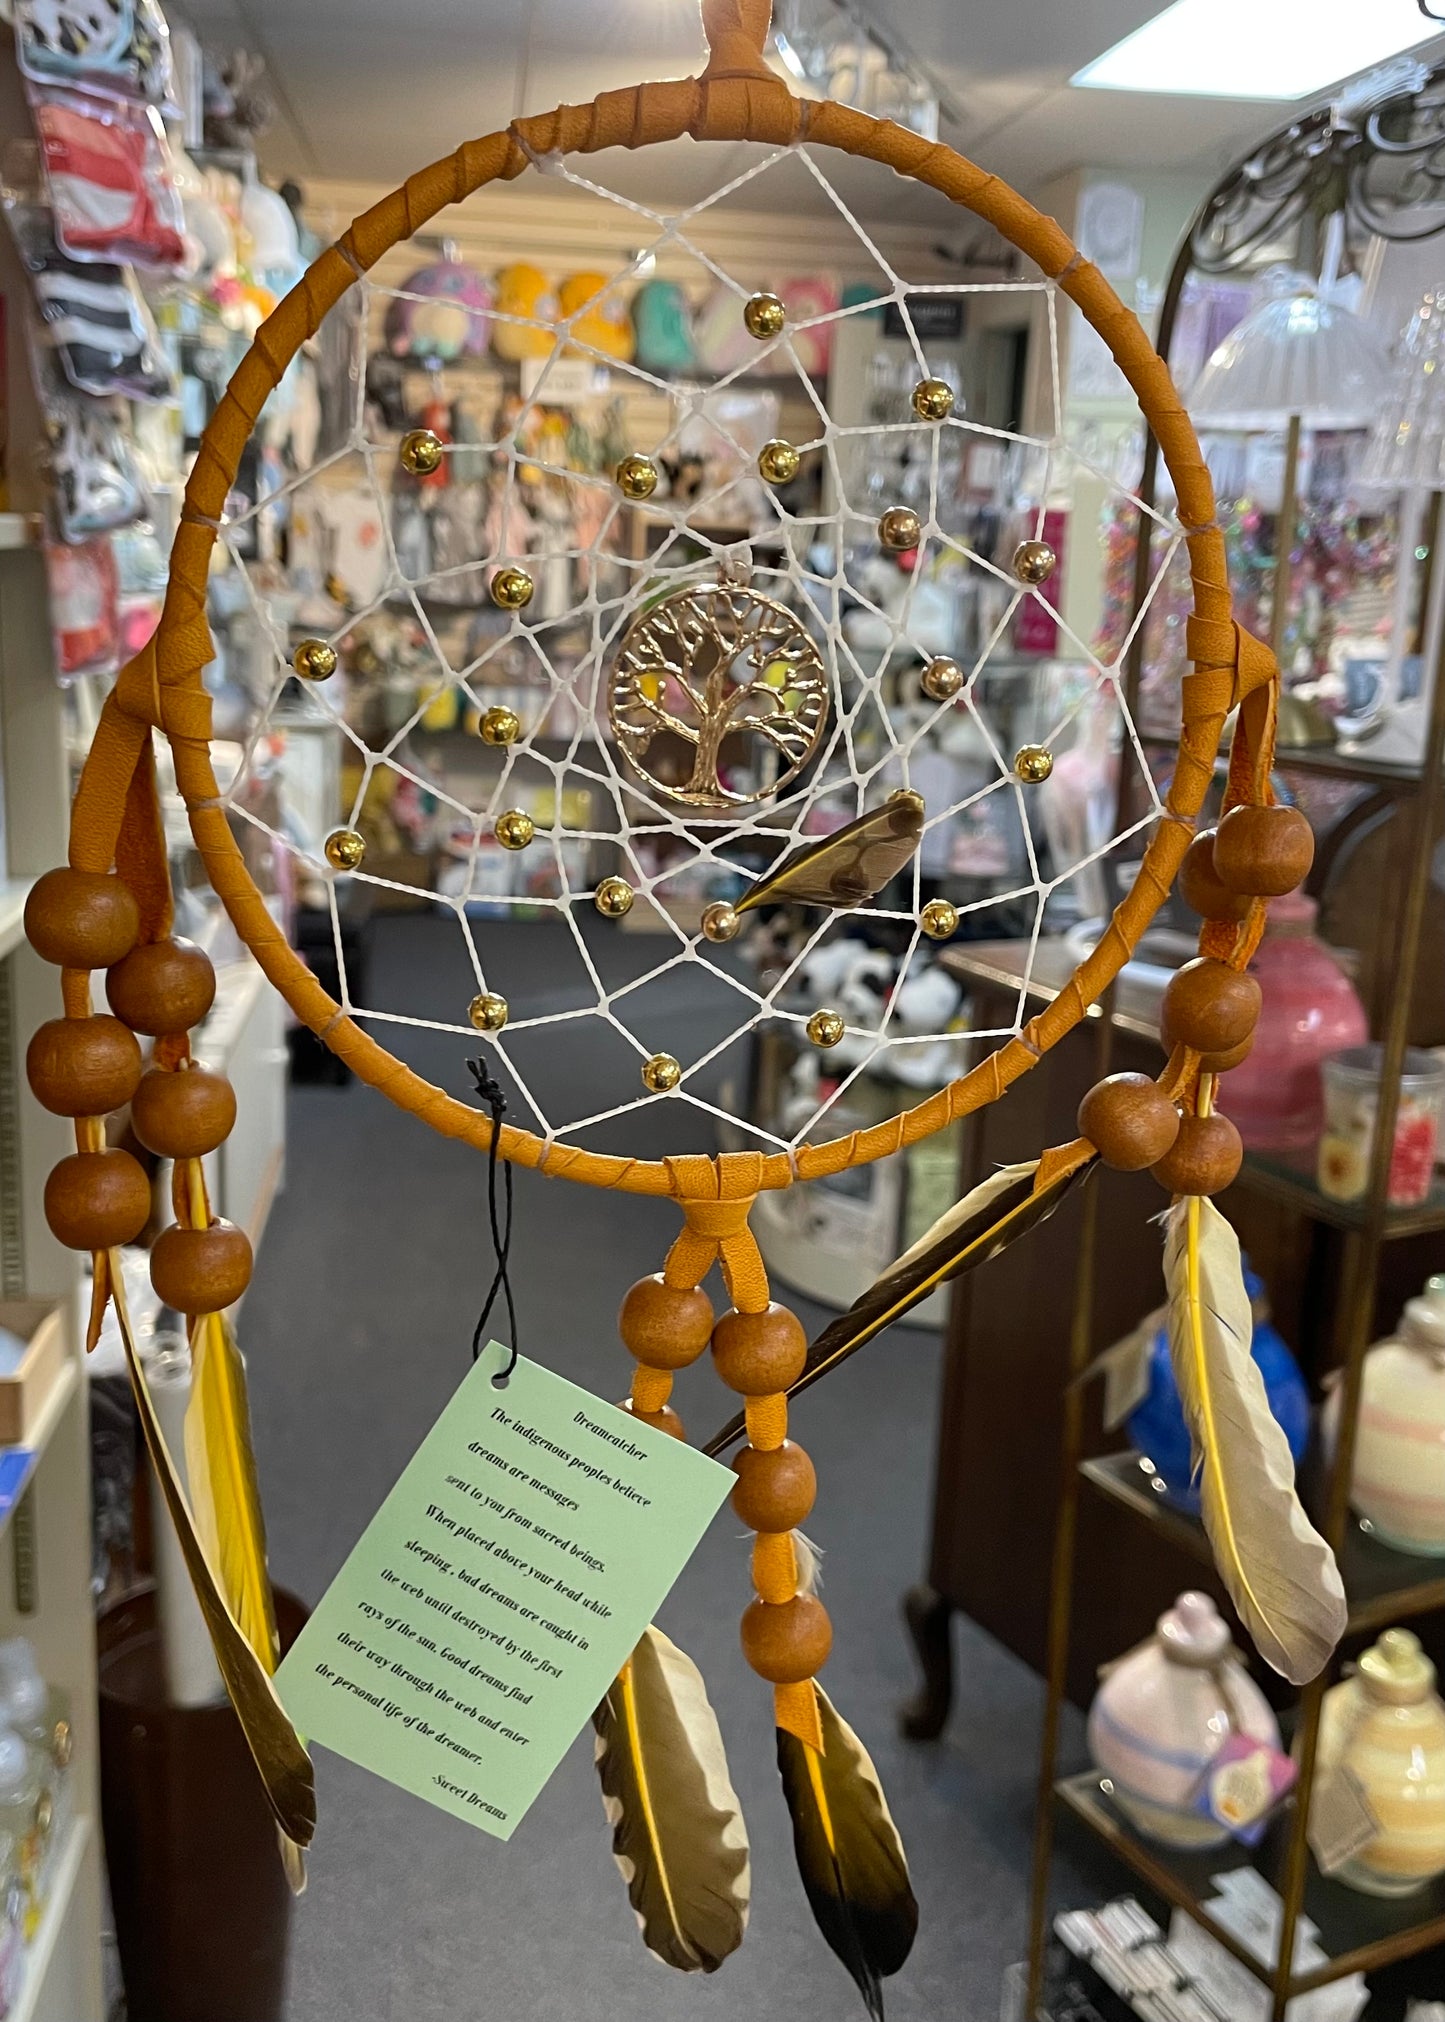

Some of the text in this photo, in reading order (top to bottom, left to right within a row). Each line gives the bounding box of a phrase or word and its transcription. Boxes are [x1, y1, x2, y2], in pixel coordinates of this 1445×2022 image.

[468, 1442, 580, 1511] dreams are messages
[490, 1407, 651, 1507] The indigenous peoples believe
[573, 1411, 648, 1461] Dreamcatcher
[425, 1504, 612, 1618] When placed above your head while
[445, 1475, 605, 1573] sent to you from sacred beings.
[358, 1602, 534, 1705] rays of the sun. Good dreams find
[380, 1569, 563, 1678] the web until destroyed by the first
[458, 1569, 481, 1588] bad
[478, 1583, 520, 1611] dreams
[519, 1607, 540, 1622] are
[539, 1619, 578, 1644] caught
[577, 1637, 589, 1651] in
[315, 1663, 482, 1765] the personal life of the dreamer.
[337, 1632, 530, 1745] their way through the web and enter
[466, 1792, 508, 1820] Dreams
